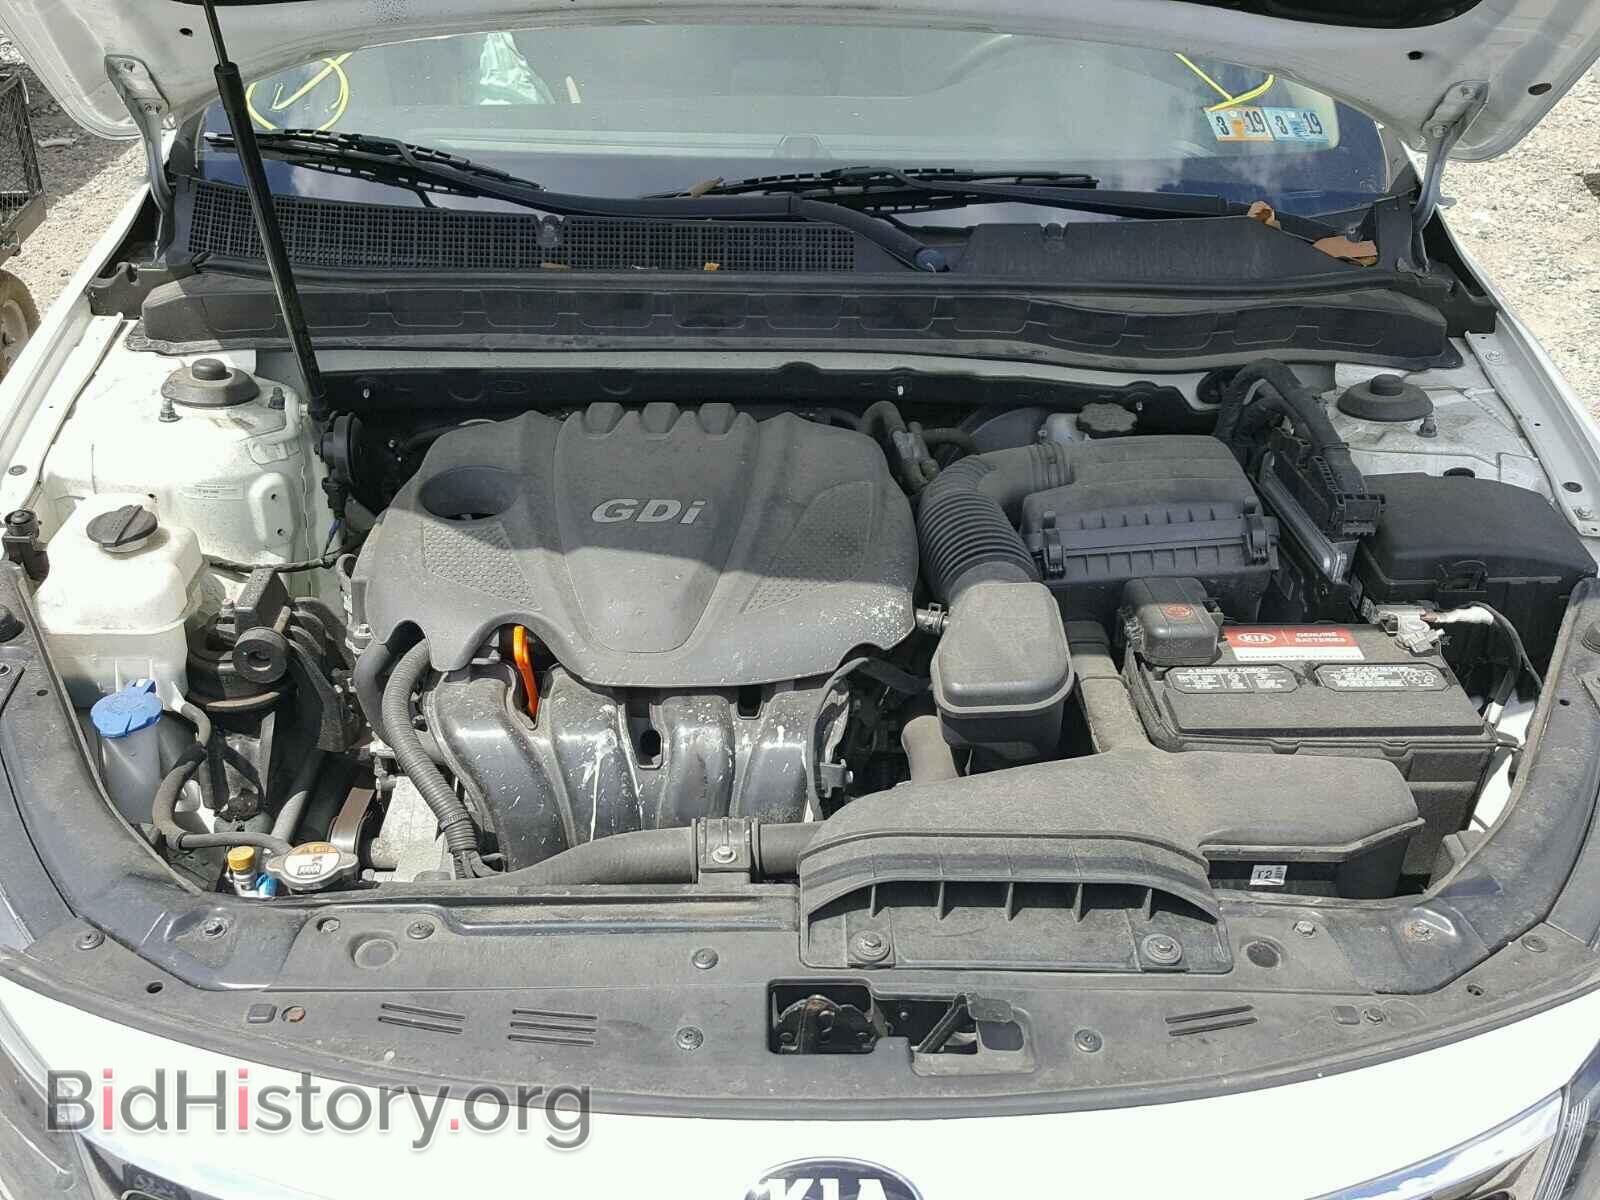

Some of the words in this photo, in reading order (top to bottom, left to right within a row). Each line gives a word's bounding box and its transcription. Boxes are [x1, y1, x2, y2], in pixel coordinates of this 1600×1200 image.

[1215, 116, 1230, 136] 3
[1245, 111, 1266, 133] 19
[1275, 115, 1289, 135] 3
[1303, 112, 1323, 135] 19
[591, 498, 706, 525] GDi
[1243, 633, 1270, 642] KIA
